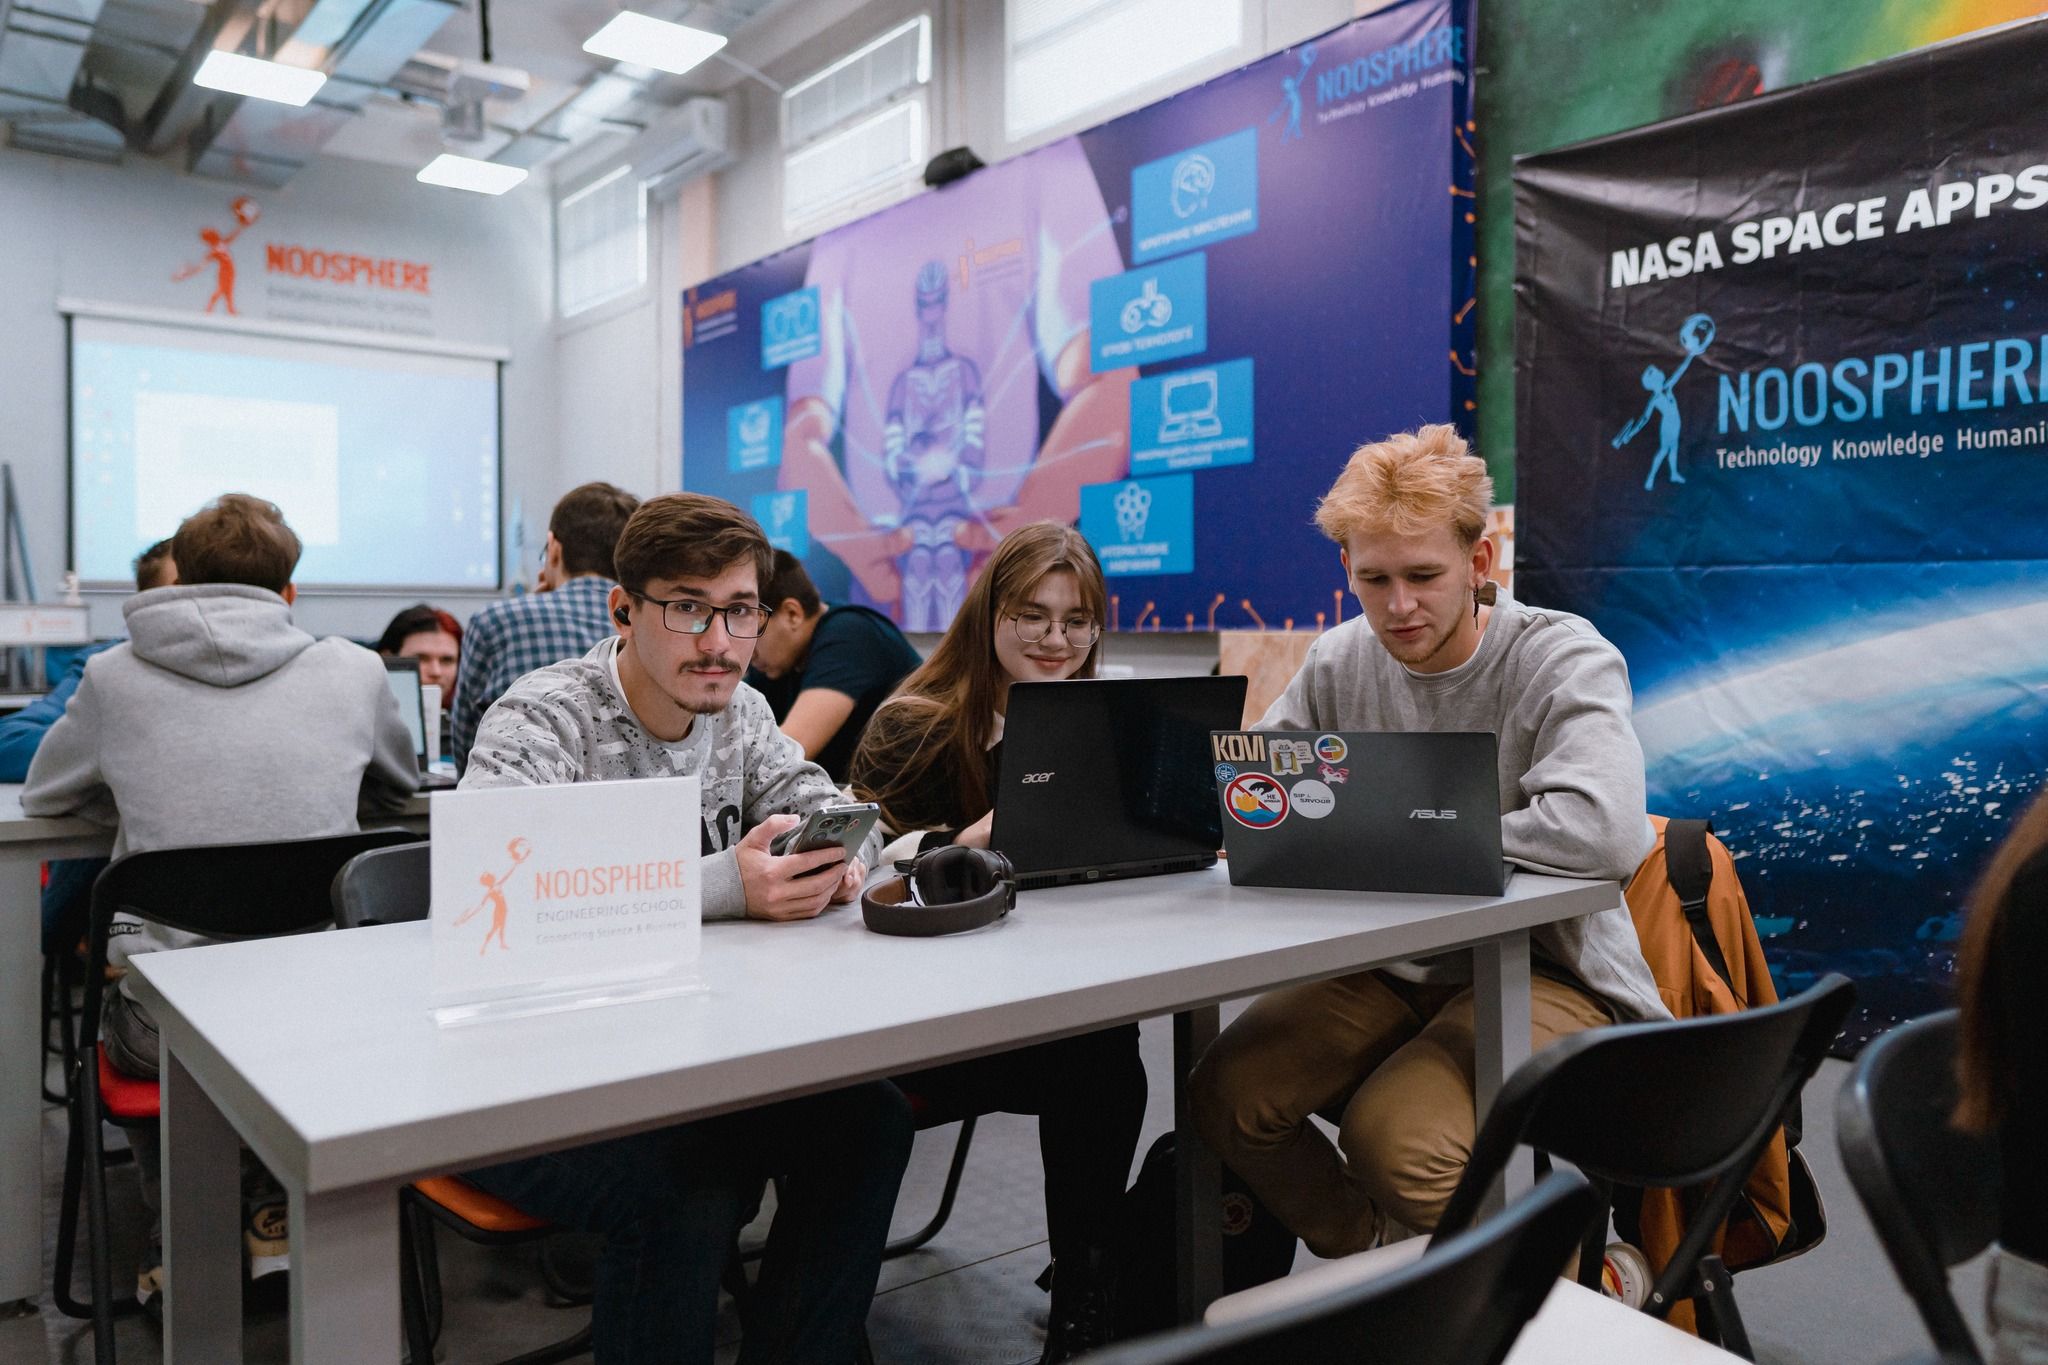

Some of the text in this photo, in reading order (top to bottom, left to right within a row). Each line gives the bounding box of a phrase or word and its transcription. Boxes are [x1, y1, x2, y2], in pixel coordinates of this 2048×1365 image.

[1316, 26, 1465, 105] NOOSPHERE
[1611, 164, 2048, 288] NASA SPACE APPS
[265, 244, 431, 294] NOOSPHERE
[1716, 420, 2048, 469] Technology Knowledge Humani
[1021, 771, 1056, 784] acer
[1408, 809, 1457, 820] ASUS
[535, 859, 686, 900] NOOSPHERE
[536, 898, 687, 925] ENGINEERING SCHOOL
